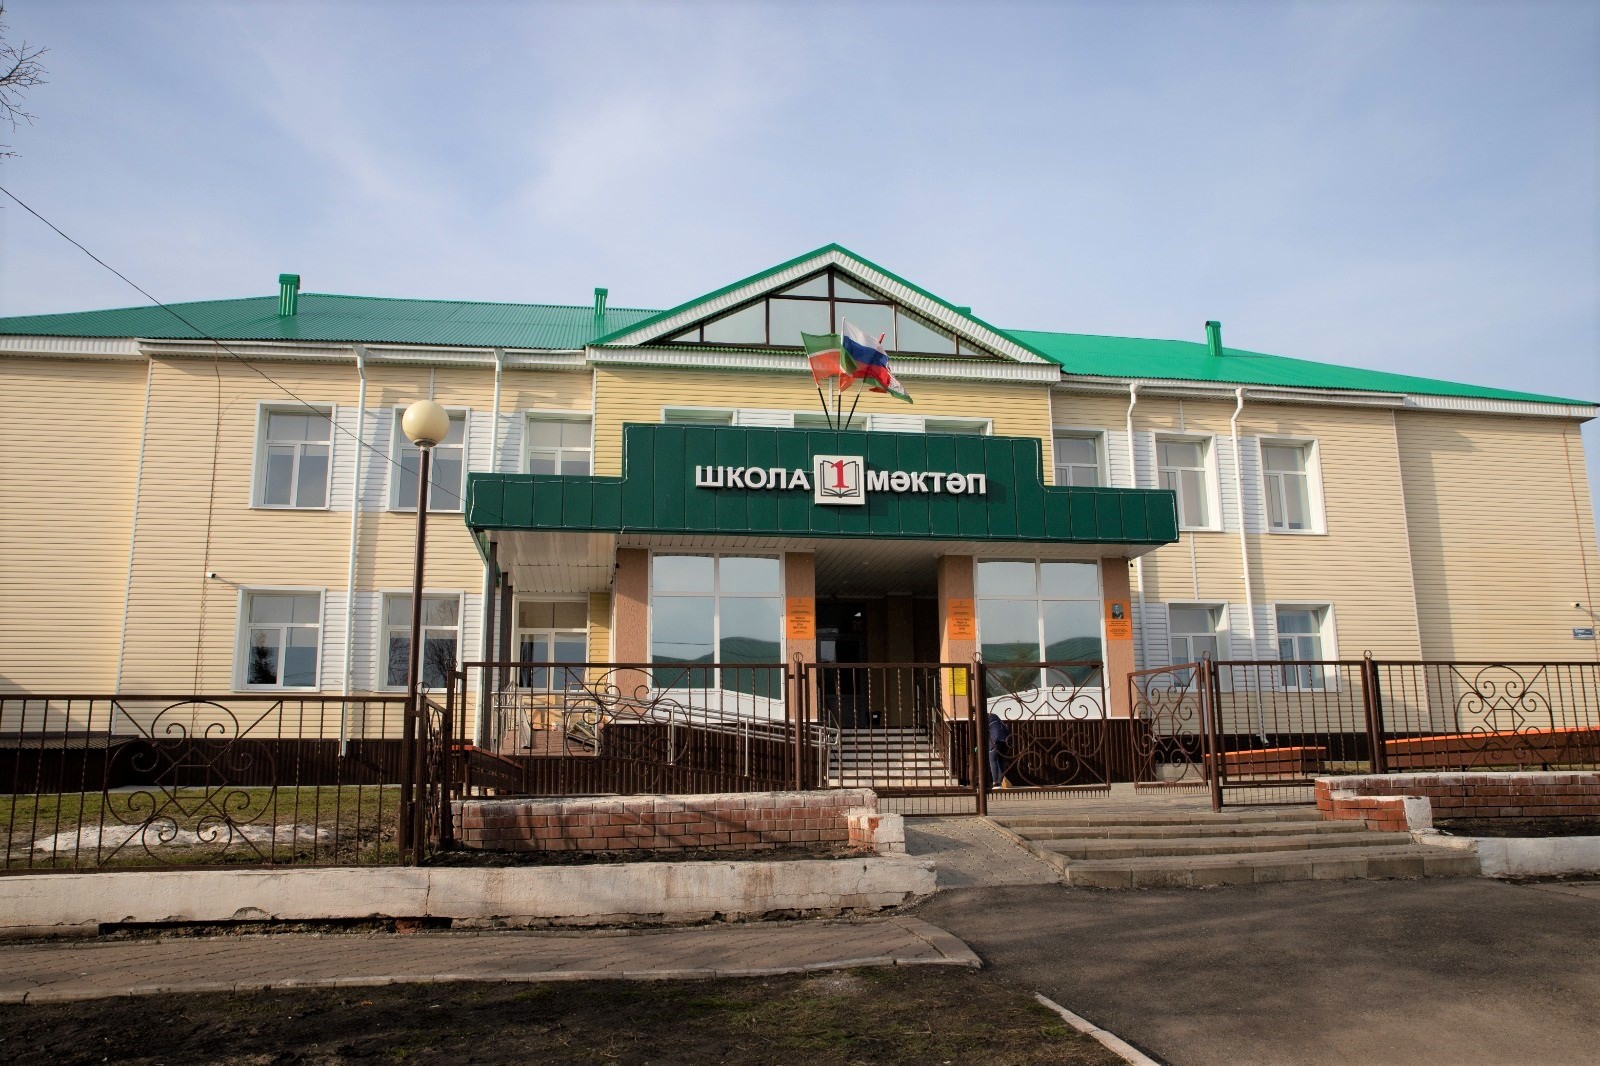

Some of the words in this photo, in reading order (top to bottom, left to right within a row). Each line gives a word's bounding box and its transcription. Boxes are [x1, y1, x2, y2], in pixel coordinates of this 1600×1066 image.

[695, 465, 811, 491] ШКОЛА
[830, 459, 850, 489] 1
[867, 470, 986, 494] МӘКТӘП
